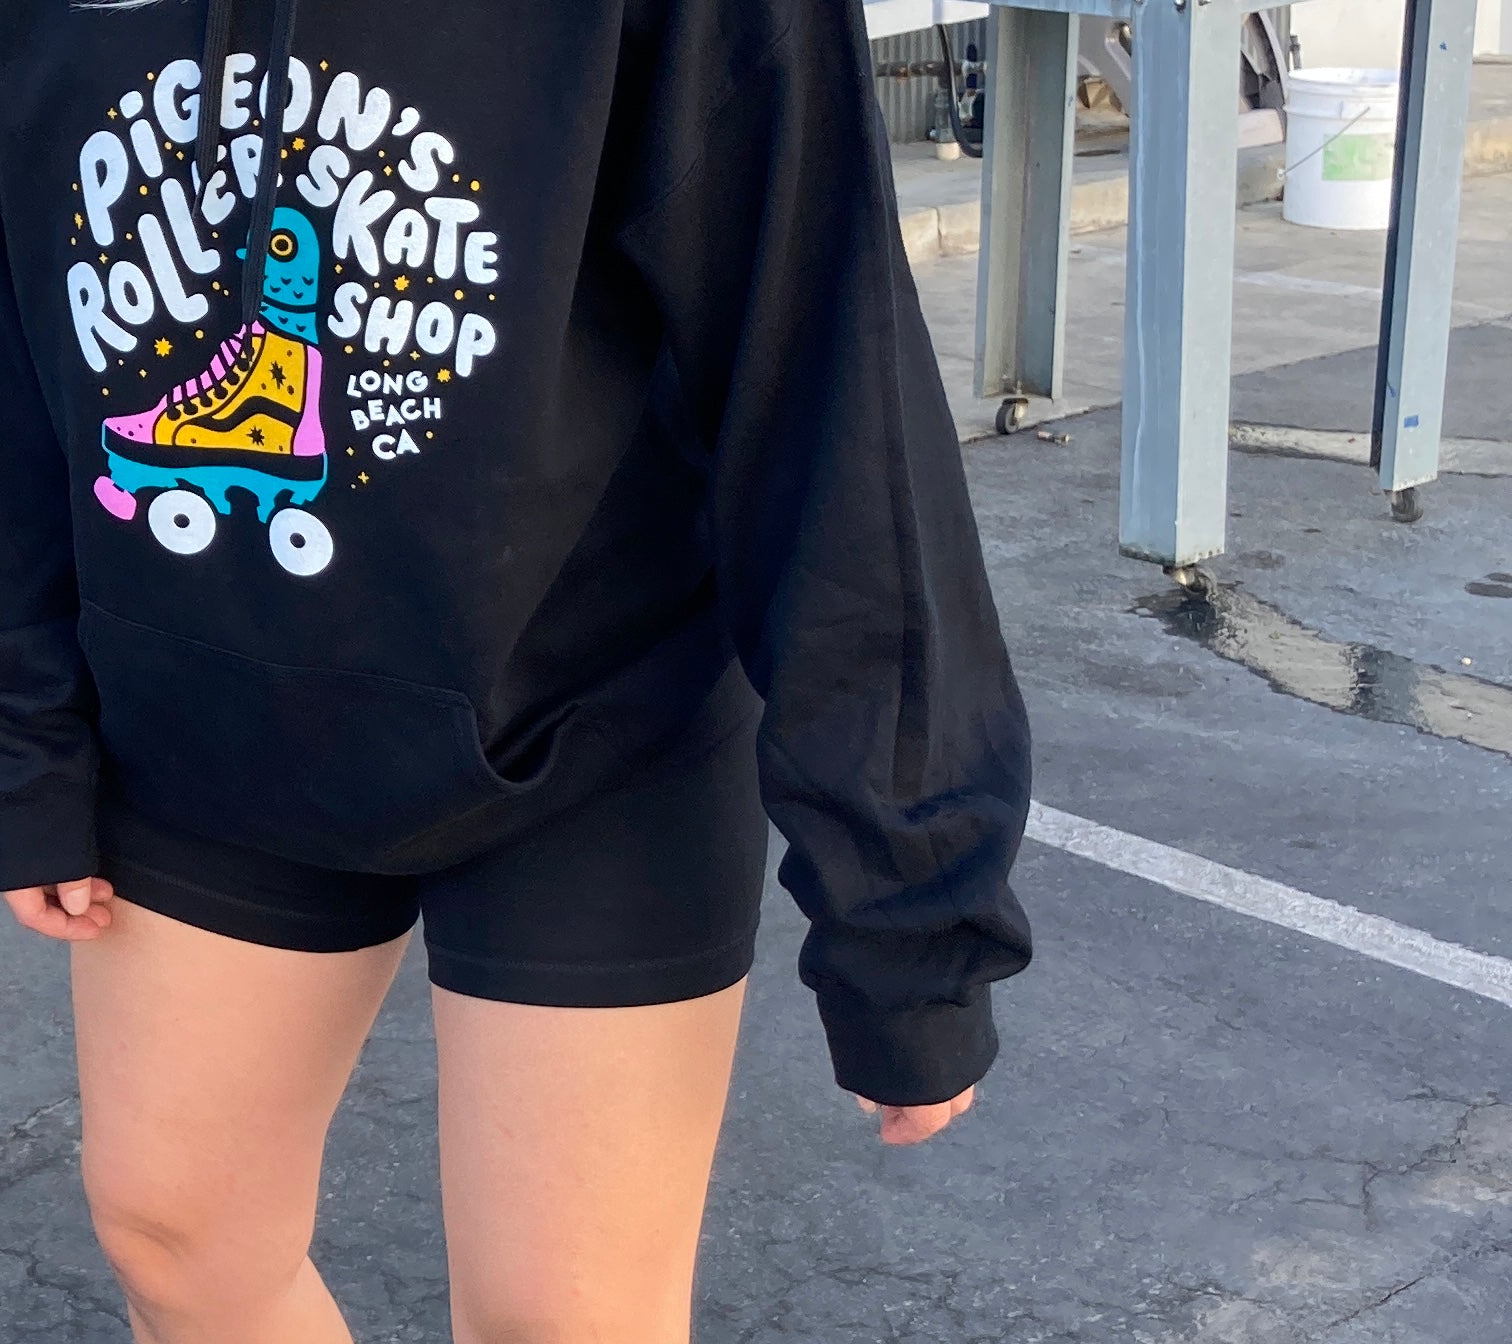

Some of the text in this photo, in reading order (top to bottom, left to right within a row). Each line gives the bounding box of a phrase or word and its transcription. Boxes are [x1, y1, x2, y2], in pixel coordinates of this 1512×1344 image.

[295, 145, 499, 285] SKATE
[328, 281, 497, 378] SHOP
[346, 369, 429, 399] LONG
[351, 397, 441, 431] BEACH
[372, 433, 420, 460] CA
